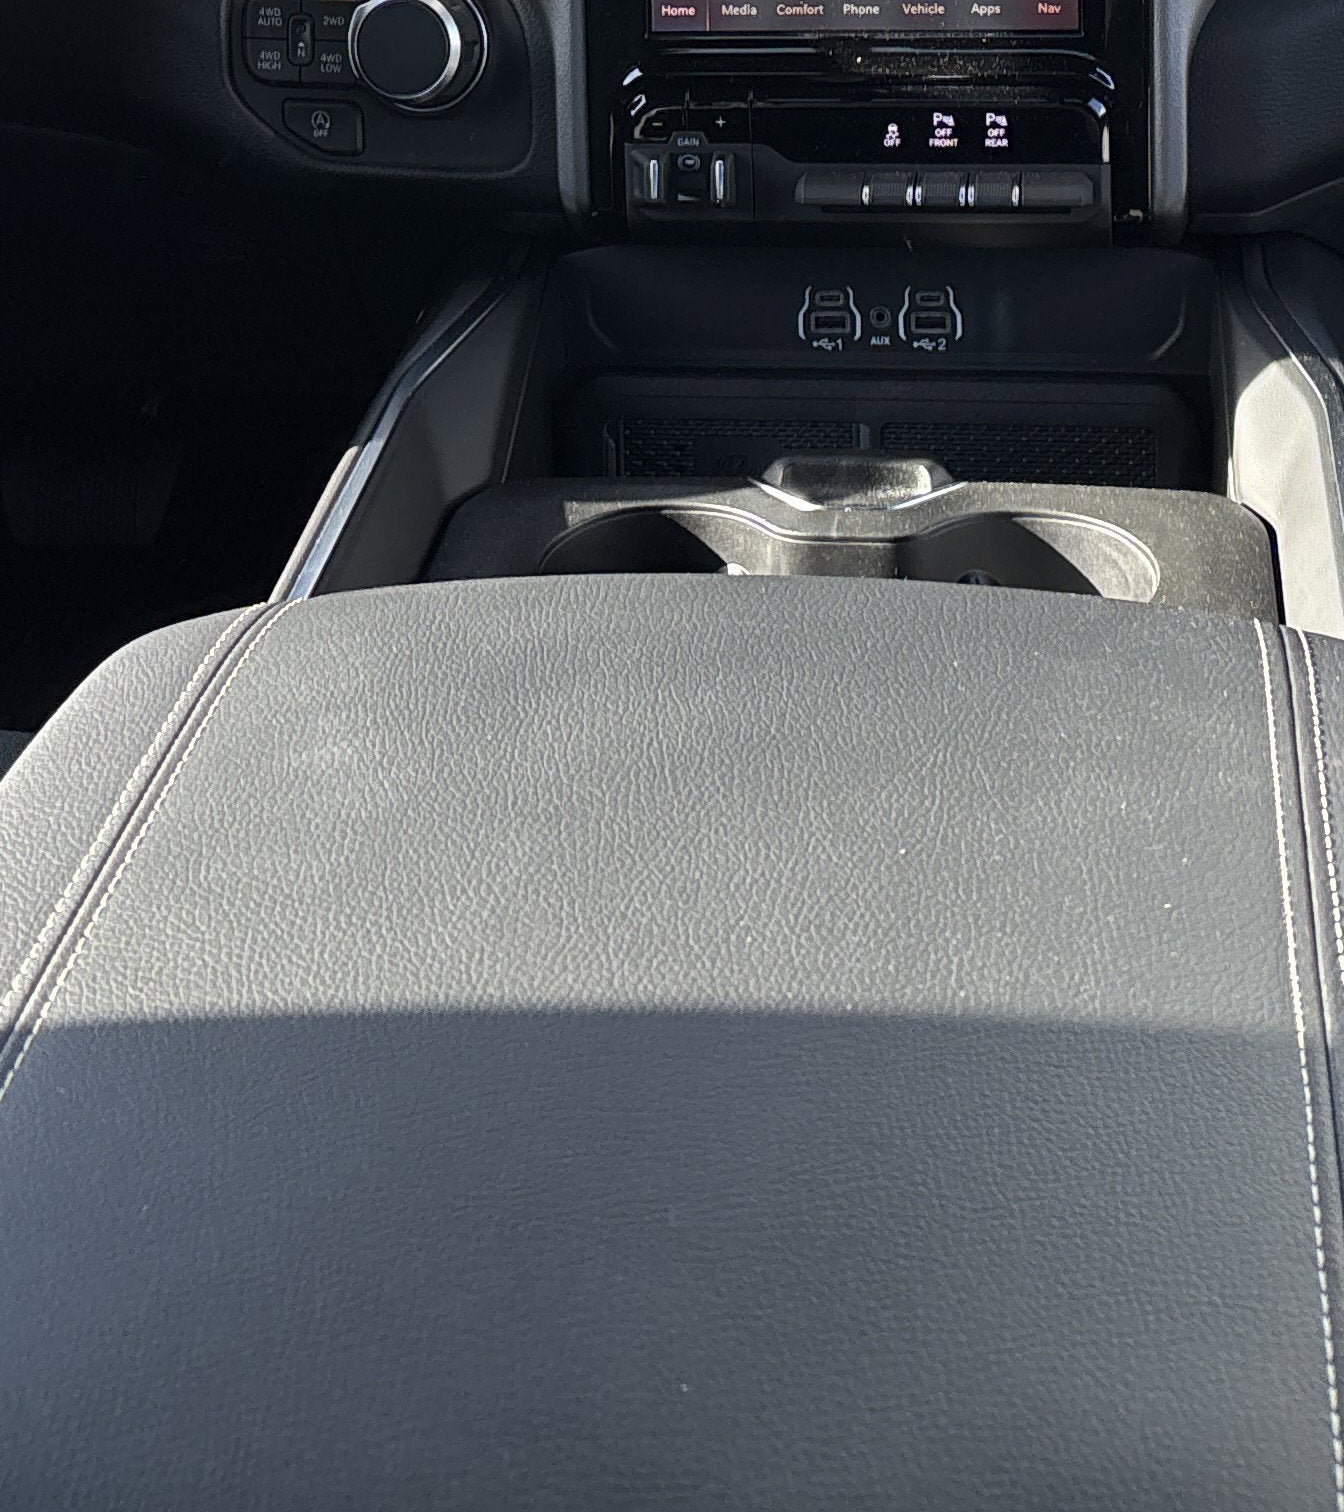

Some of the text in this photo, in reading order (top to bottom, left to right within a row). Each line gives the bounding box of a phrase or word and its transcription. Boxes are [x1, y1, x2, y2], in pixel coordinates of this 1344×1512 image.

[259, 7, 281, 16] 4WD
[661, 5, 696, 16] Home
[721, 4, 757, 15] Media
[777, 4, 824, 15] Comfort
[843, 3, 880, 15] Phone
[902, 3, 945, 14] Vehicle
[971, 3, 1001, 16] Apps
[1037, 3, 1061, 14] Nav
[258, 17, 282, 26] AUTO
[323, 16, 344, 26] 2WD
[260, 51, 281, 60] 4WD
[297, 48, 305, 58] N
[320, 53, 342, 63] 4WD
[258, 61, 281, 71] HIGH
[321, 63, 342, 73] LOW
[313, 129, 328, 137] OFF
[935, 128, 952, 137] OFF
[987, 128, 1005, 137] OFF
[677, 138, 700, 147] GAIN
[883, 139, 901, 147] OFF
[929, 138, 958, 147] FRONT
[985, 138, 1008, 147] REAR
[836, 339, 843, 351] 1
[870, 336, 891, 346] AUX
[937, 338, 947, 351] 2
